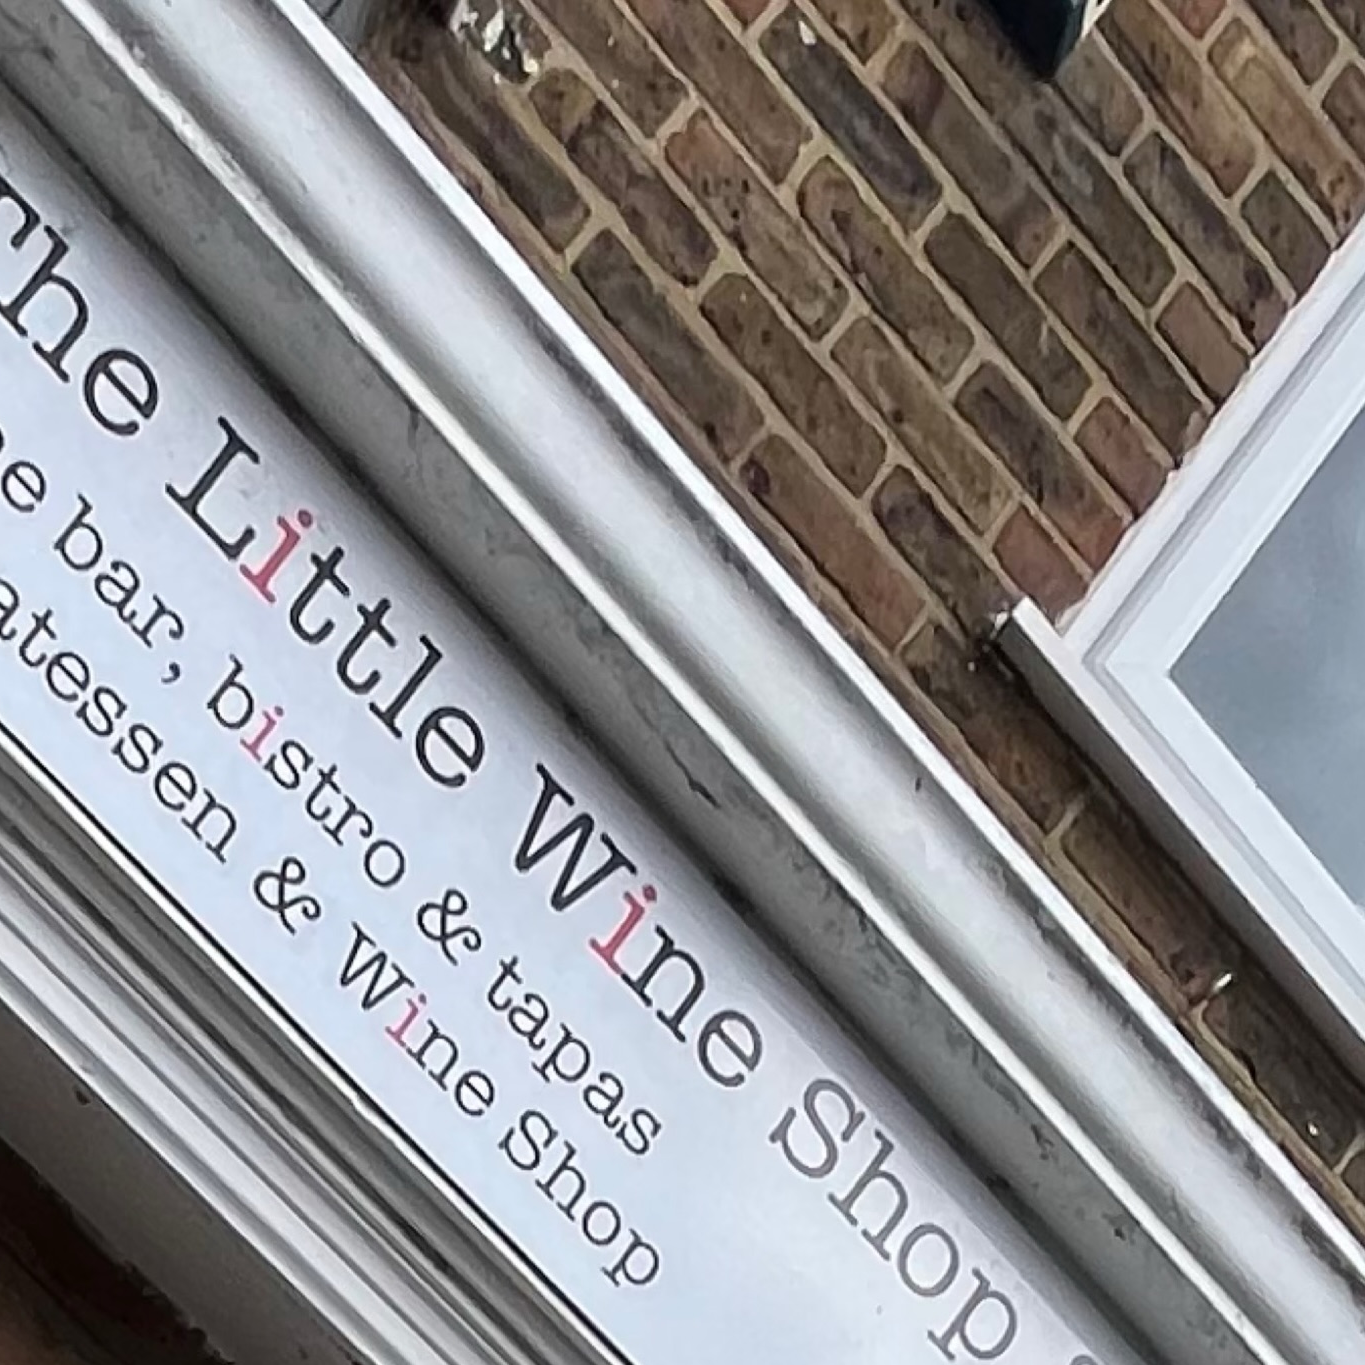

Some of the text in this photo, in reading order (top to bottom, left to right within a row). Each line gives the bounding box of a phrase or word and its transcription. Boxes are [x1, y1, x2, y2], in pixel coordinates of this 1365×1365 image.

[53, 493, 184, 684] bar,
[206, 654, 406, 889] bistro
[416, 888, 482, 966] &
[487, 955, 661, 1156] tapas
[165, 416, 485, 788] Little
[514, 763, 762, 1087] Wine
[769, 1079, 1017, 1361] Shop
[253, 856, 321, 936] &
[339, 921, 495, 1117] Wine
[497, 1109, 659, 1287] Shop
